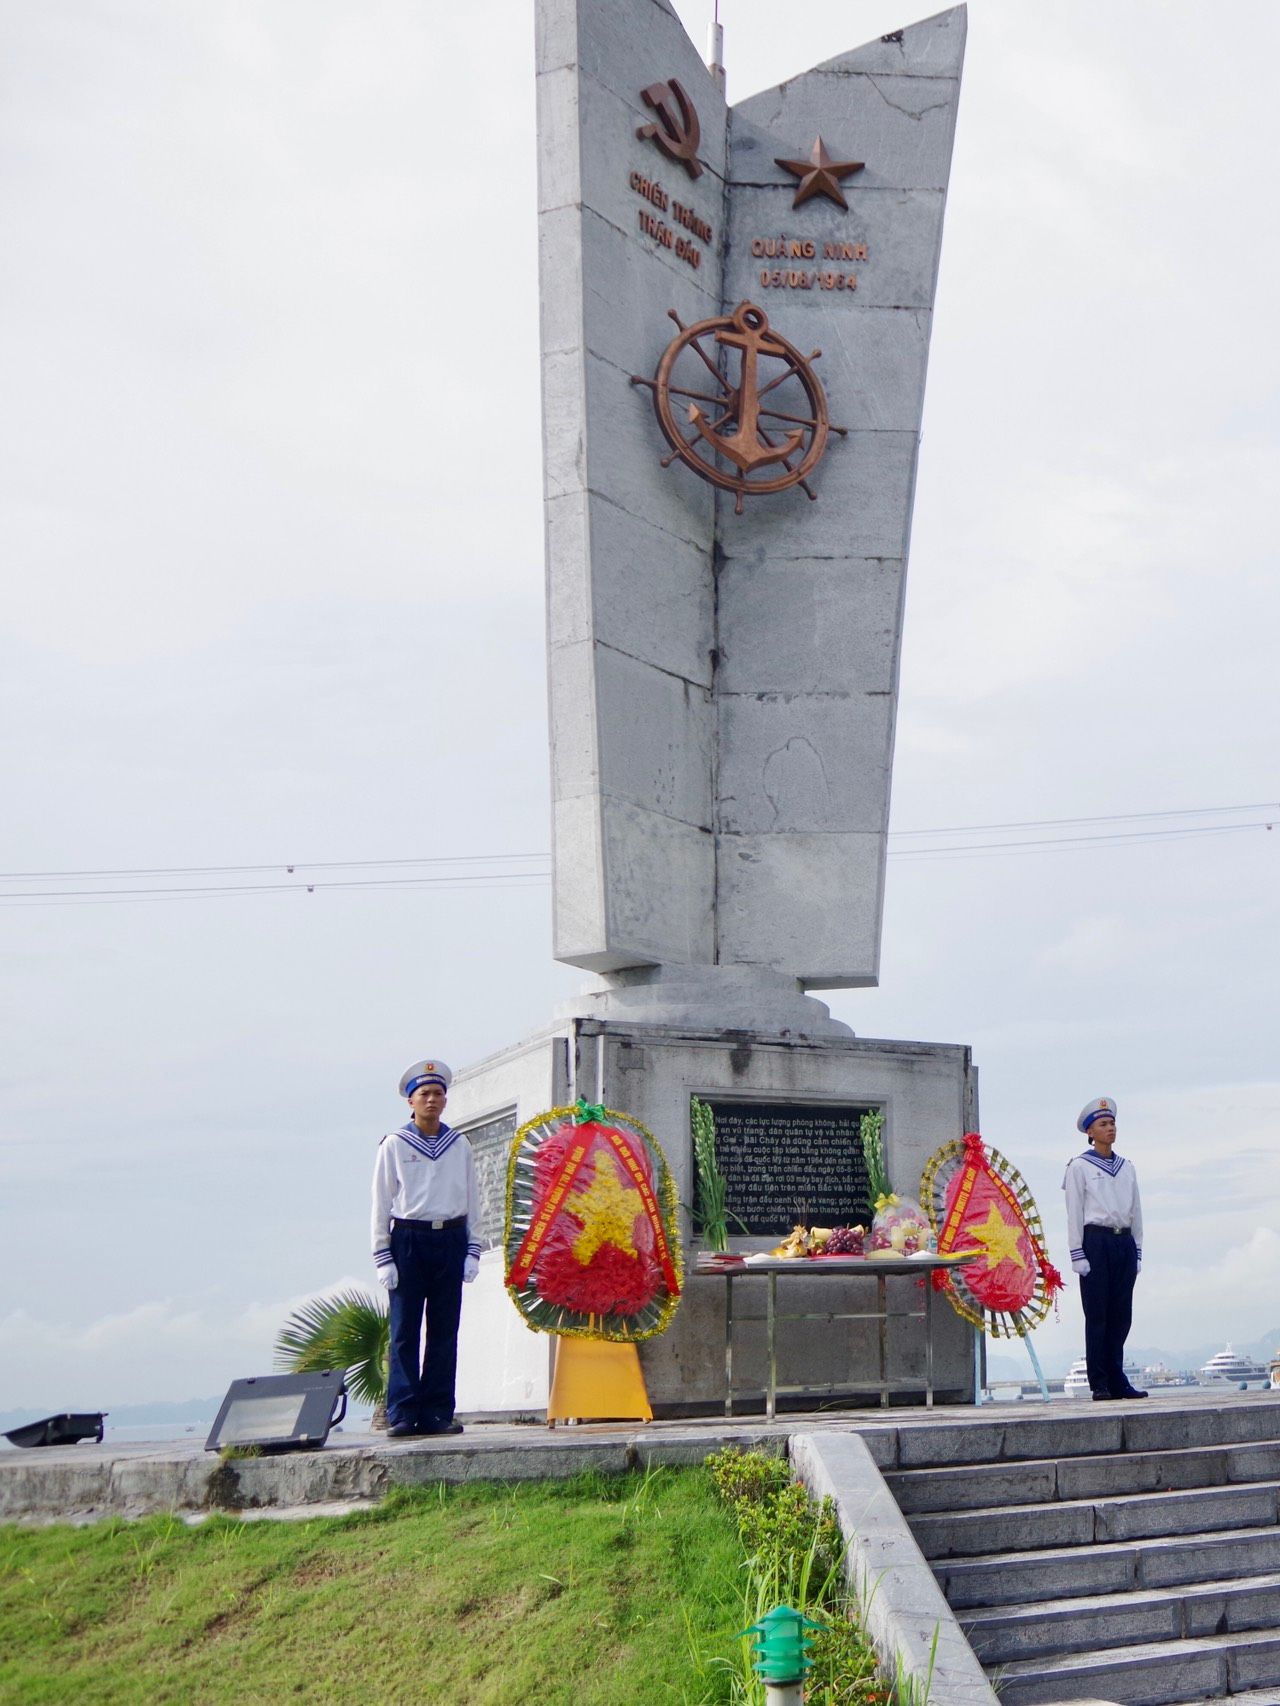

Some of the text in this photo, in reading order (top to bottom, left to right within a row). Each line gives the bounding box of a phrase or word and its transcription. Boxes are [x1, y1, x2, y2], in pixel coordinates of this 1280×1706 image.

[630, 171, 668, 212] CHIẾN
[639, 209, 672, 249] TRẬN
[823, 242, 868, 261] NINH
[760, 268, 857, 291] 05/08/1964
